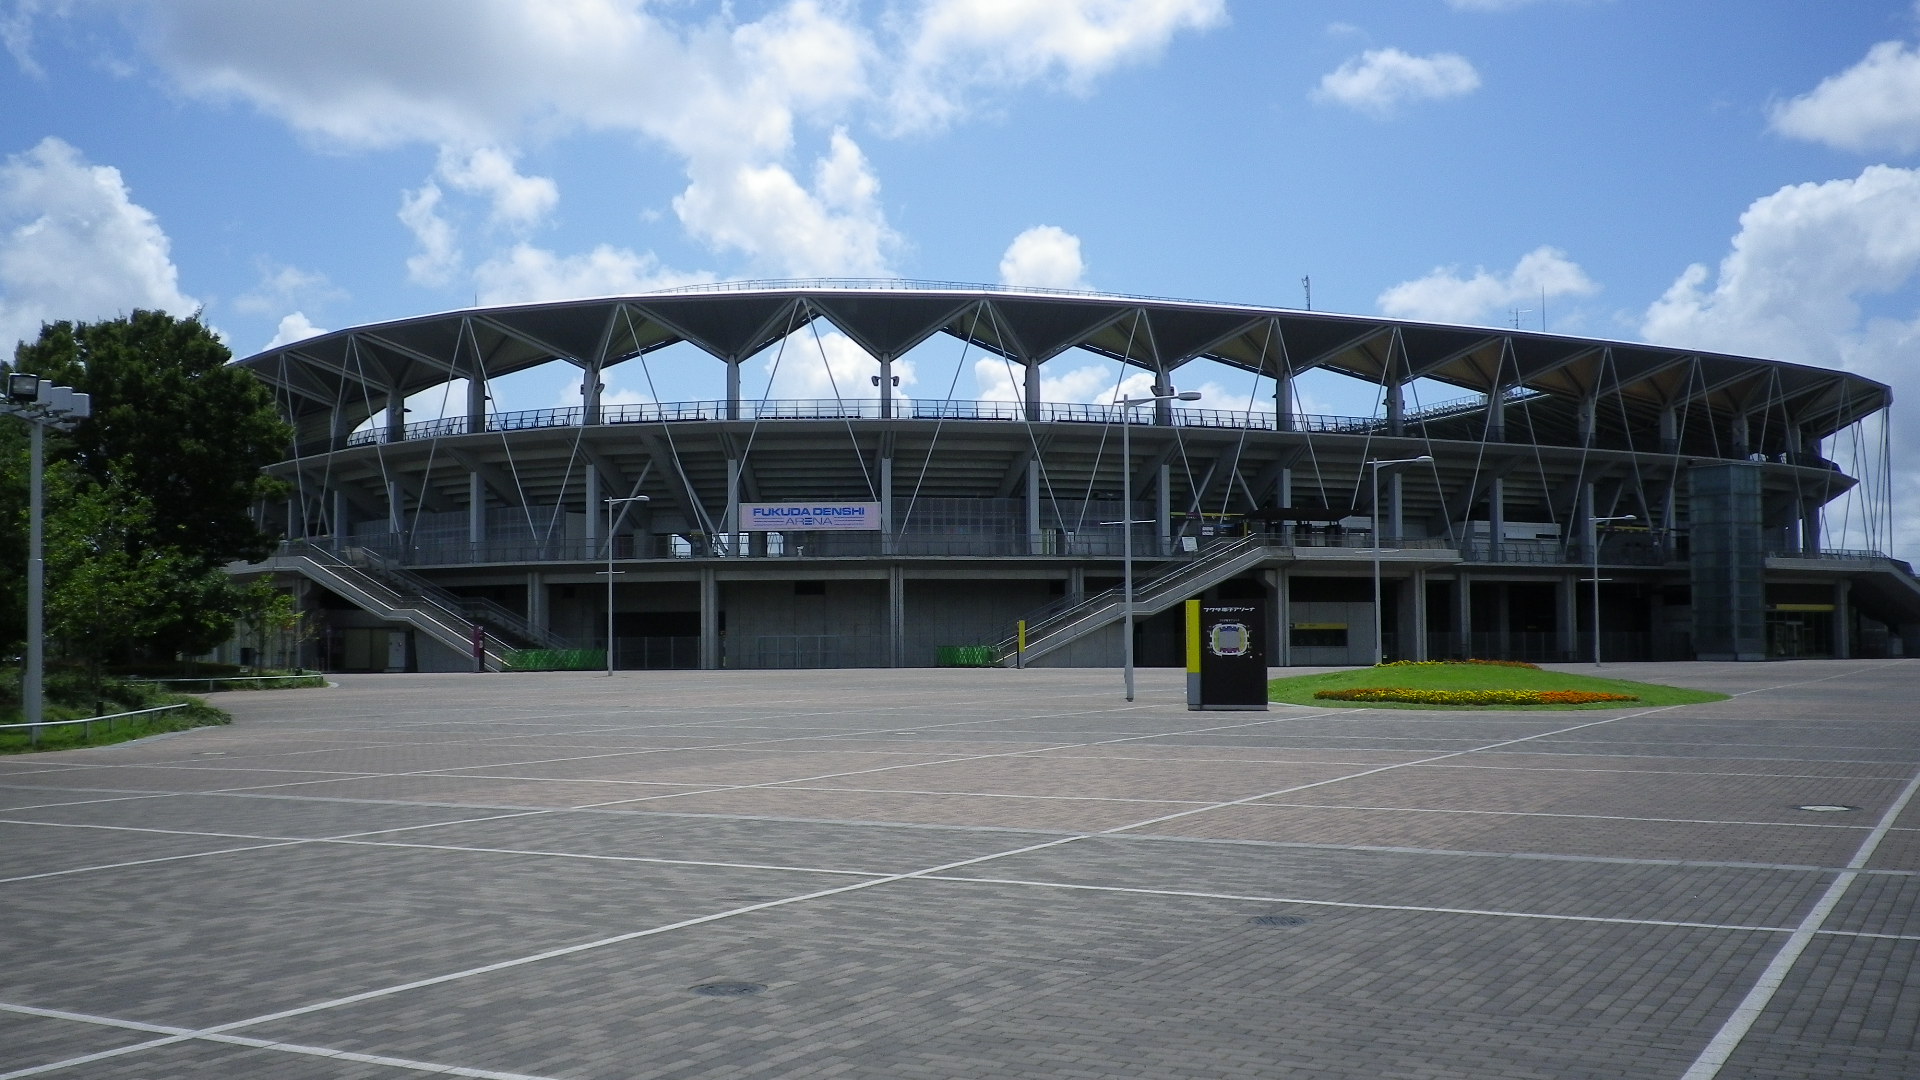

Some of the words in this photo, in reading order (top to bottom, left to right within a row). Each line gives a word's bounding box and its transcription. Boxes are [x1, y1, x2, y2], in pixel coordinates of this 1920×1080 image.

[753, 507, 811, 517] FUKUDA
[812, 507, 865, 517] DENSHI
[785, 517, 833, 525] ARENA
